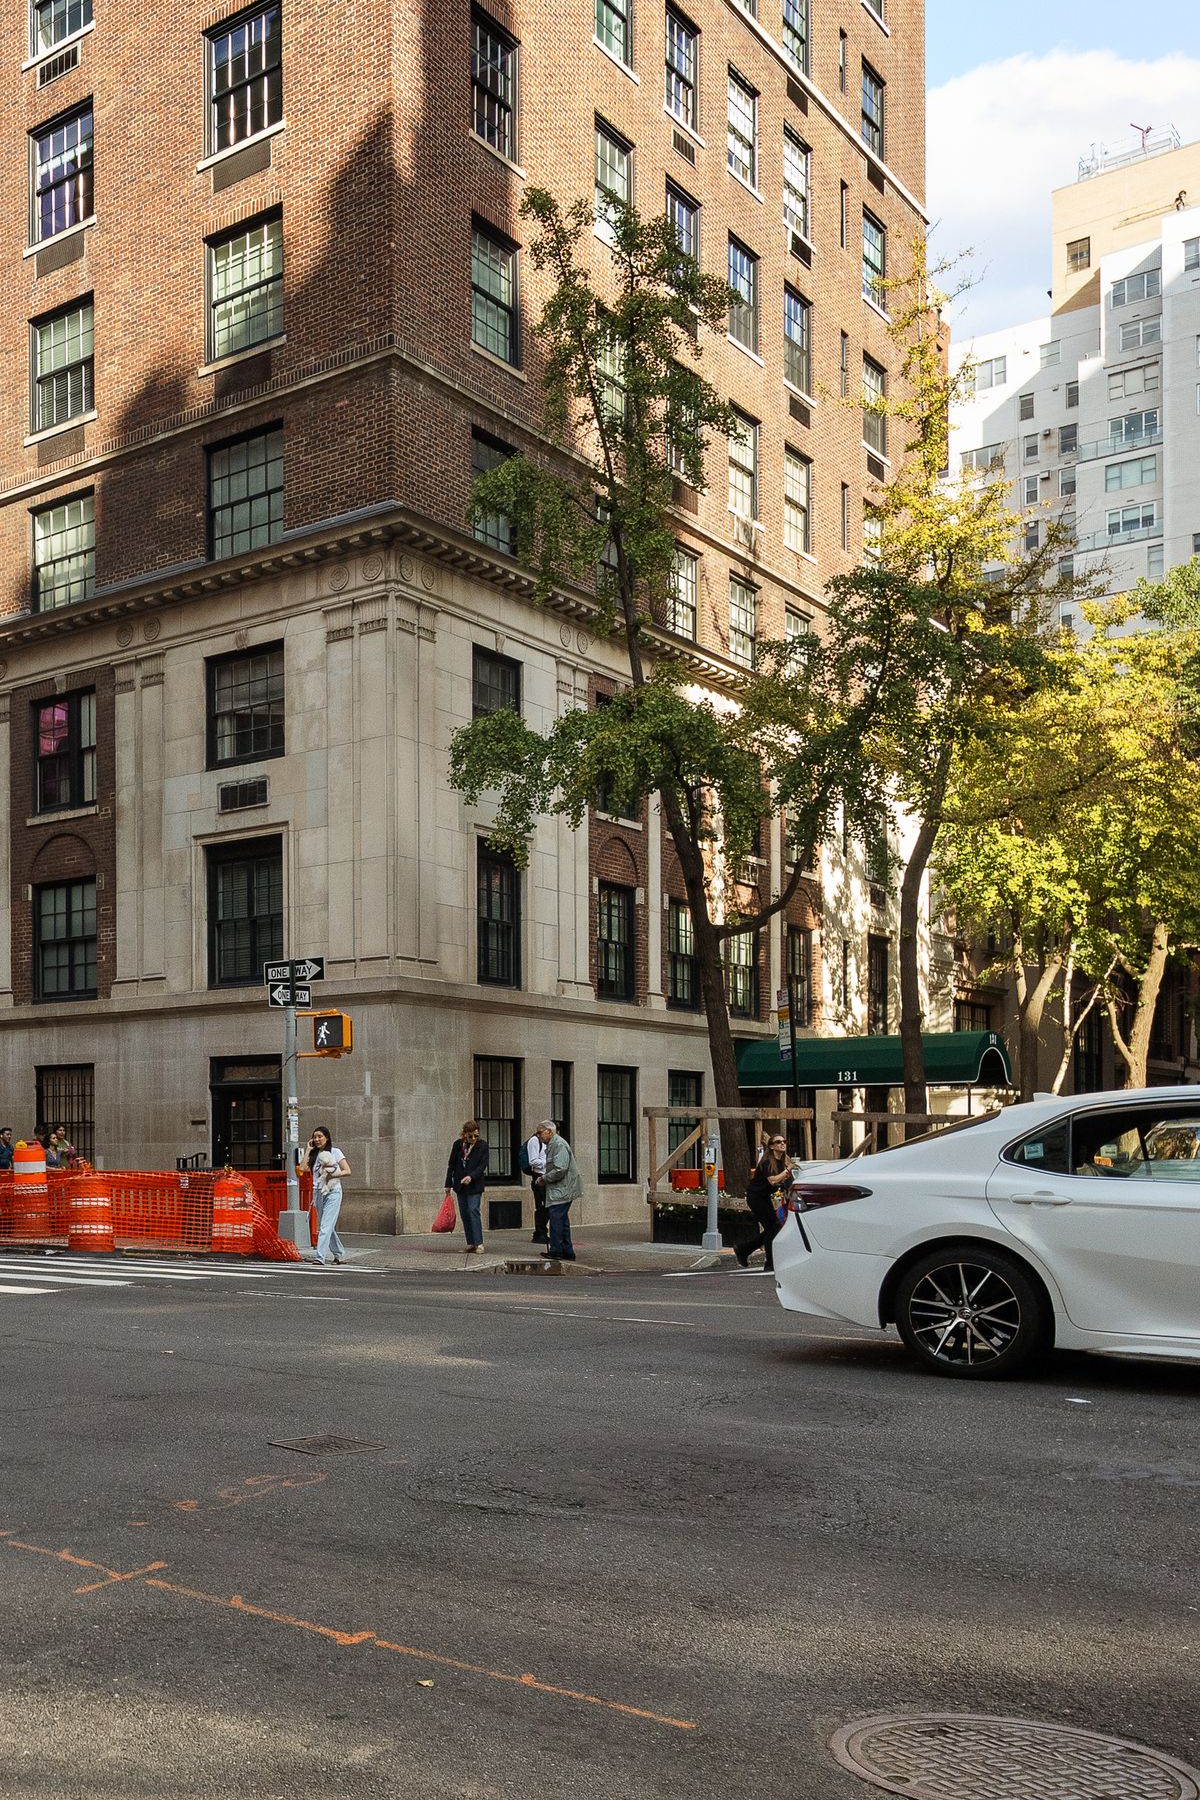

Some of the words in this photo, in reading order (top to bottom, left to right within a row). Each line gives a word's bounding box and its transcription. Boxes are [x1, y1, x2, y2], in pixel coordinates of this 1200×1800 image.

[271, 967, 287, 978] ONE
[295, 964, 313, 976] WAY
[277, 990, 290, 1000] ONE
[837, 1070, 858, 1081] 131
